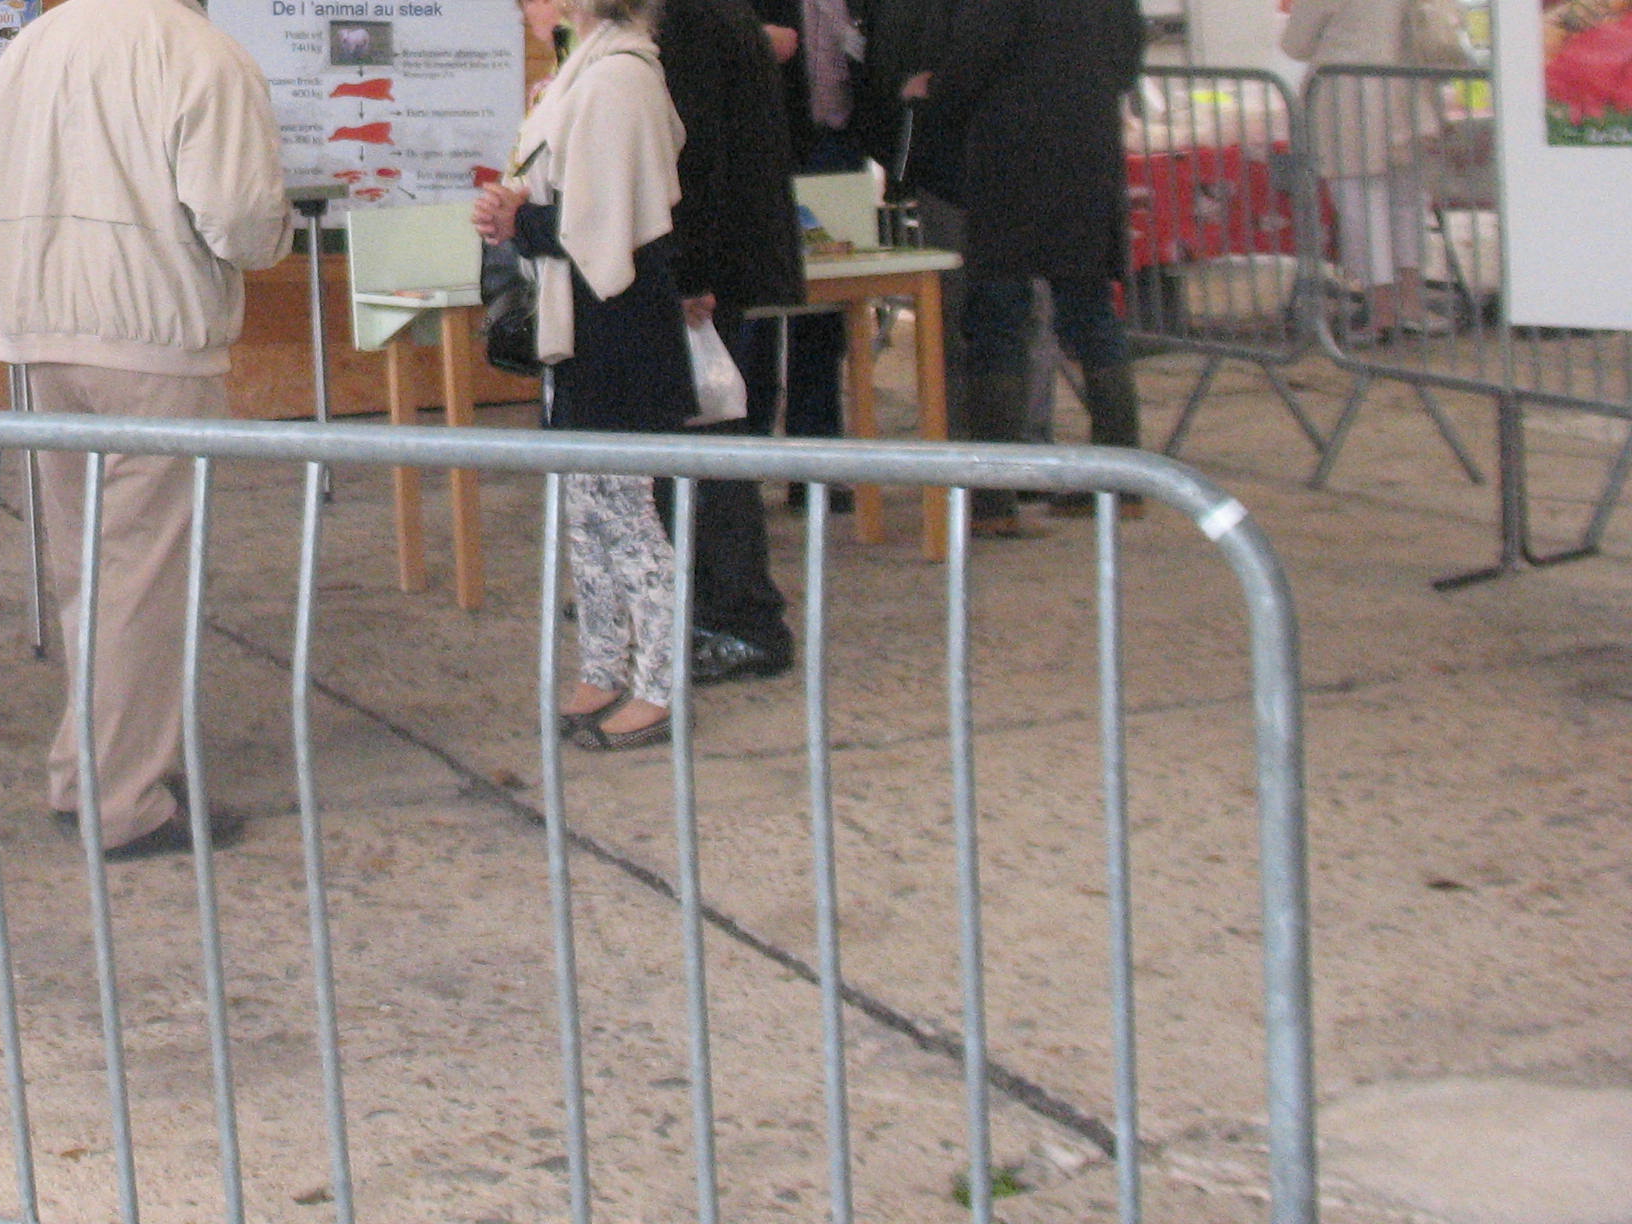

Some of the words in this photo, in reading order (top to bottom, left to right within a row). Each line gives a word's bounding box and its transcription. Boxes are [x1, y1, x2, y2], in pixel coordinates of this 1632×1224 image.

[272, 1, 297, 16] De
[374, 4, 395, 17] au
[399, 2, 443, 17] steak
